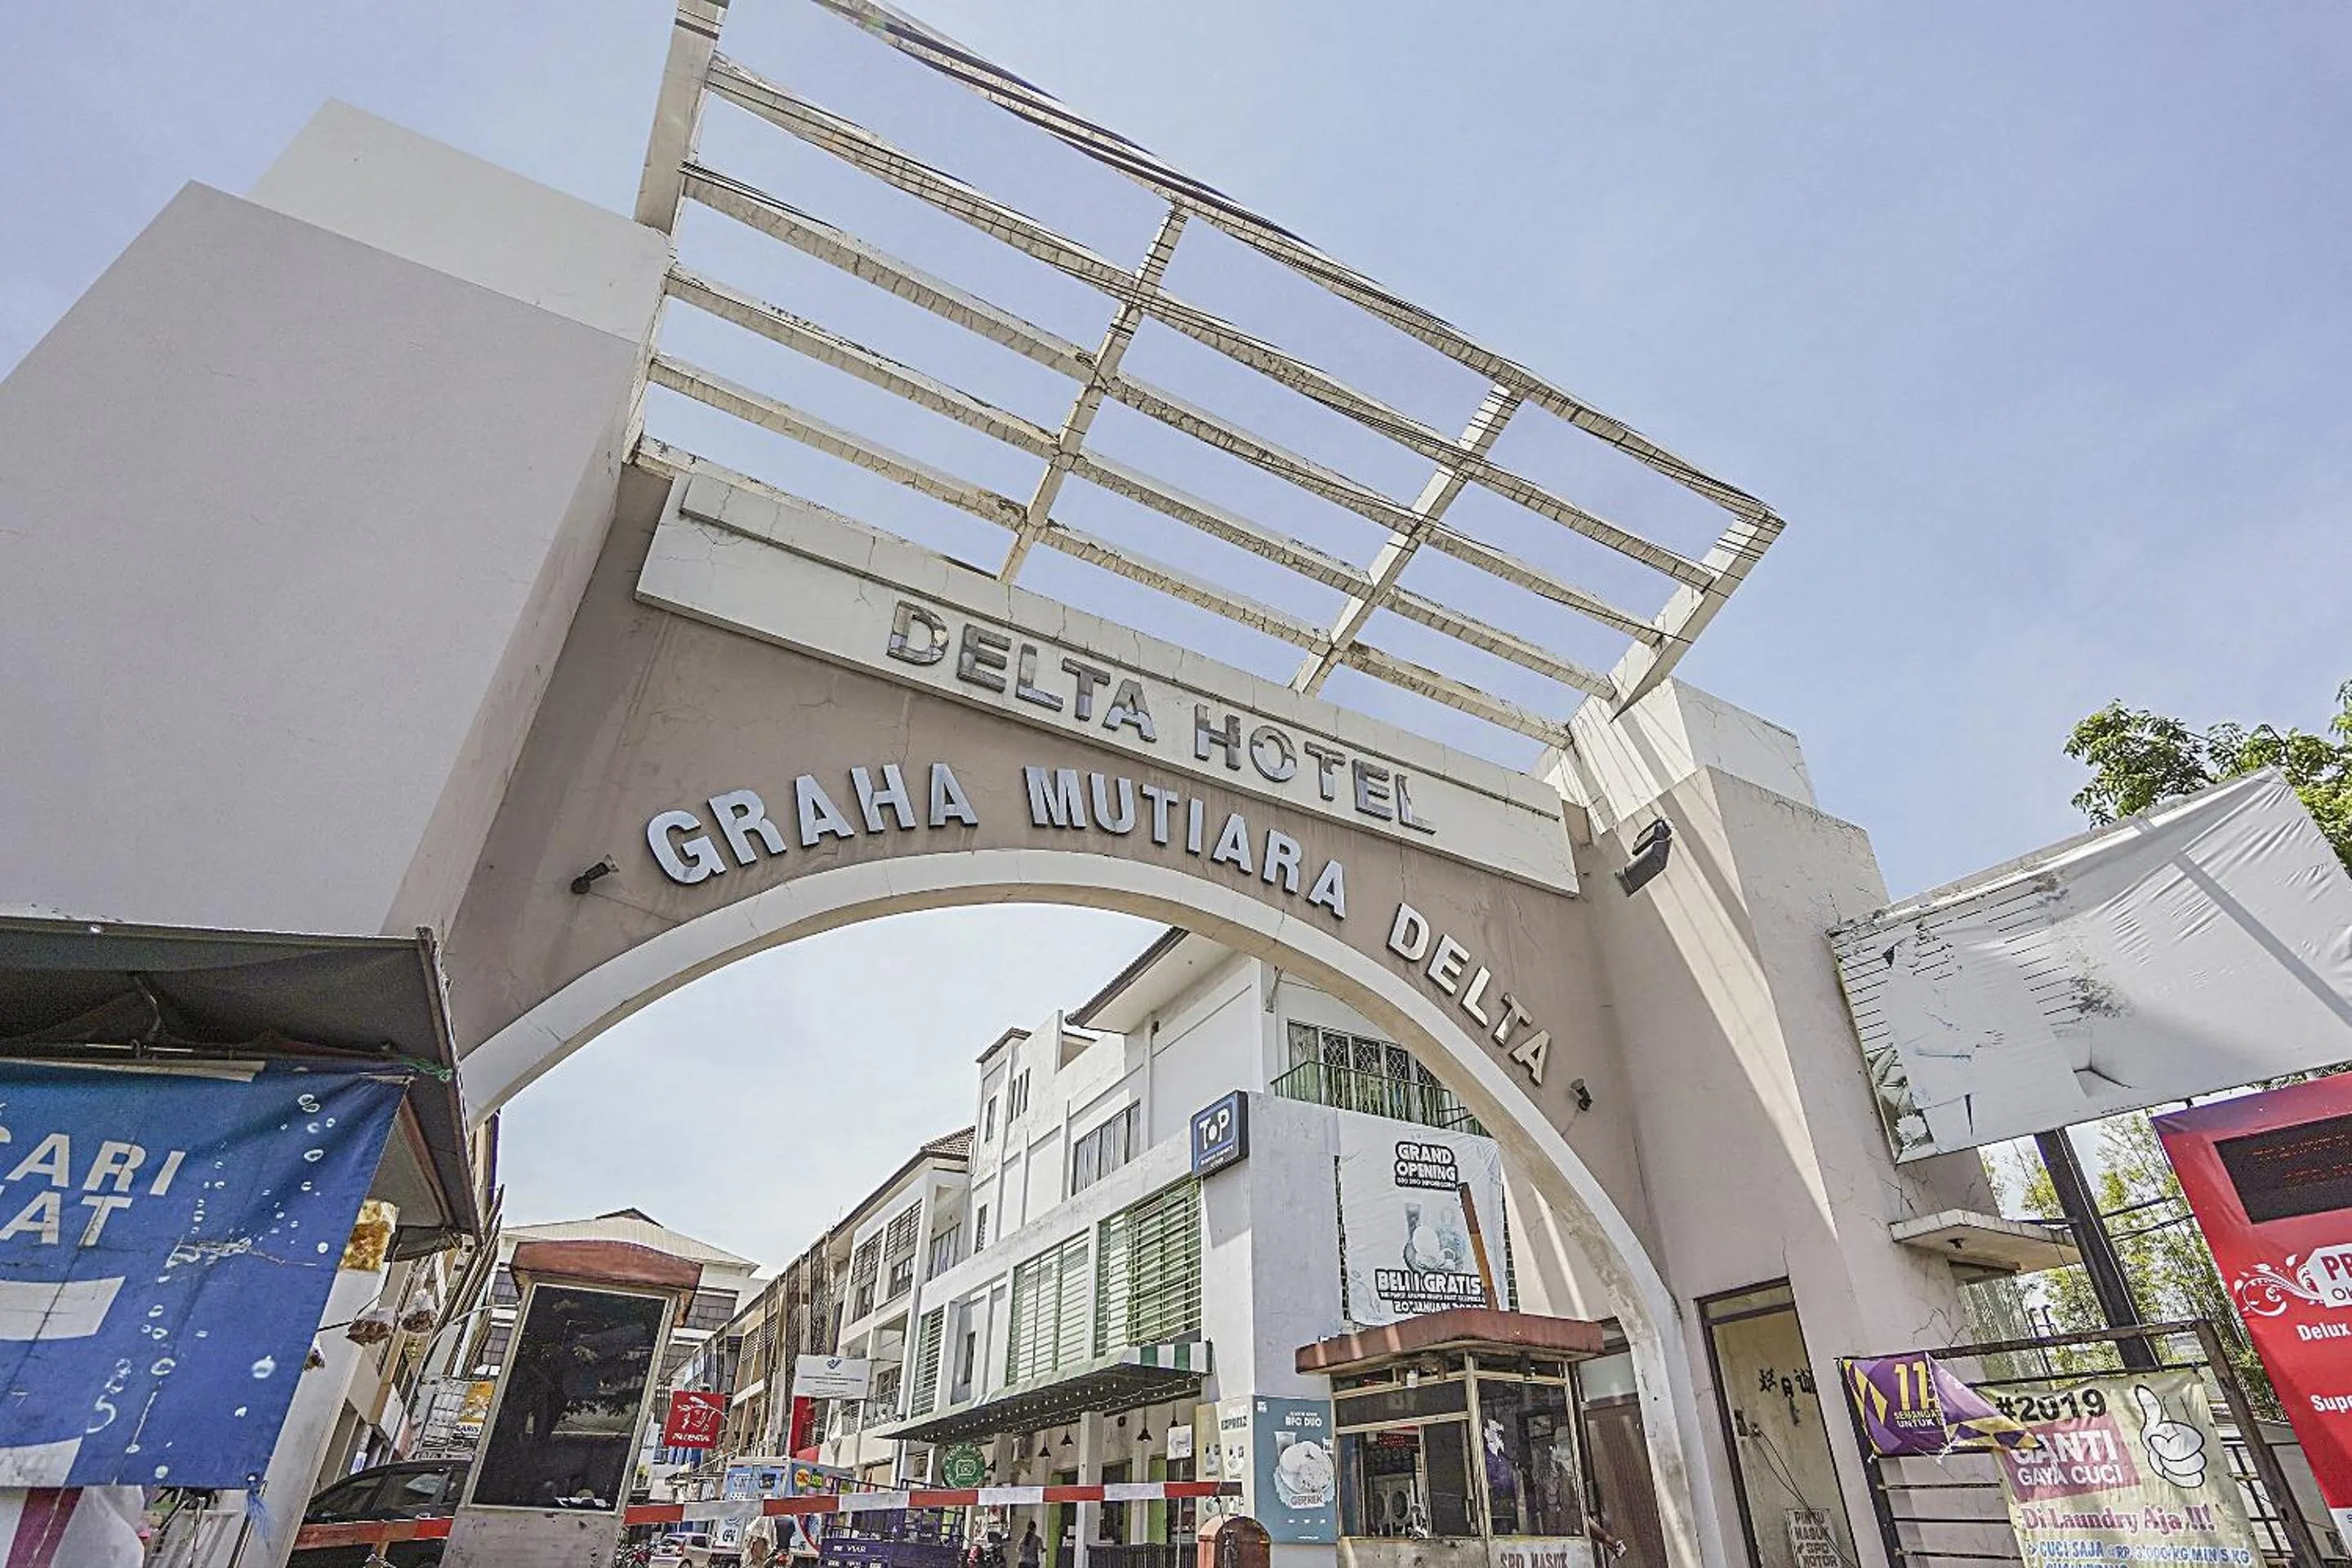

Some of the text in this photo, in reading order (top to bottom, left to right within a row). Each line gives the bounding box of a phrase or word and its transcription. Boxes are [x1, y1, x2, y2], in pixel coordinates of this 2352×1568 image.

[886, 600, 1436, 834] DELTA HOTEL
[647, 762, 1552, 1085] GRAHA MUTIARA DELTA
[0, 1126, 186, 1196] ARI
[1396, 1144, 1453, 1164] GRAND
[1396, 1160, 1456, 1181] OPENING
[0, 1186, 132, 1248] AT
[1423, 1274, 1482, 1295] GRATIS
[1995, 1388, 2107, 1423] #2019
[2017, 1464, 2123, 1486] GAYA CUCI
[2022, 1508, 2047, 1530] Di
[2048, 1507, 2139, 1534] Laundry
[2144, 1507, 2183, 1535] Aja
[2072, 1541, 2105, 1558] SAJA
